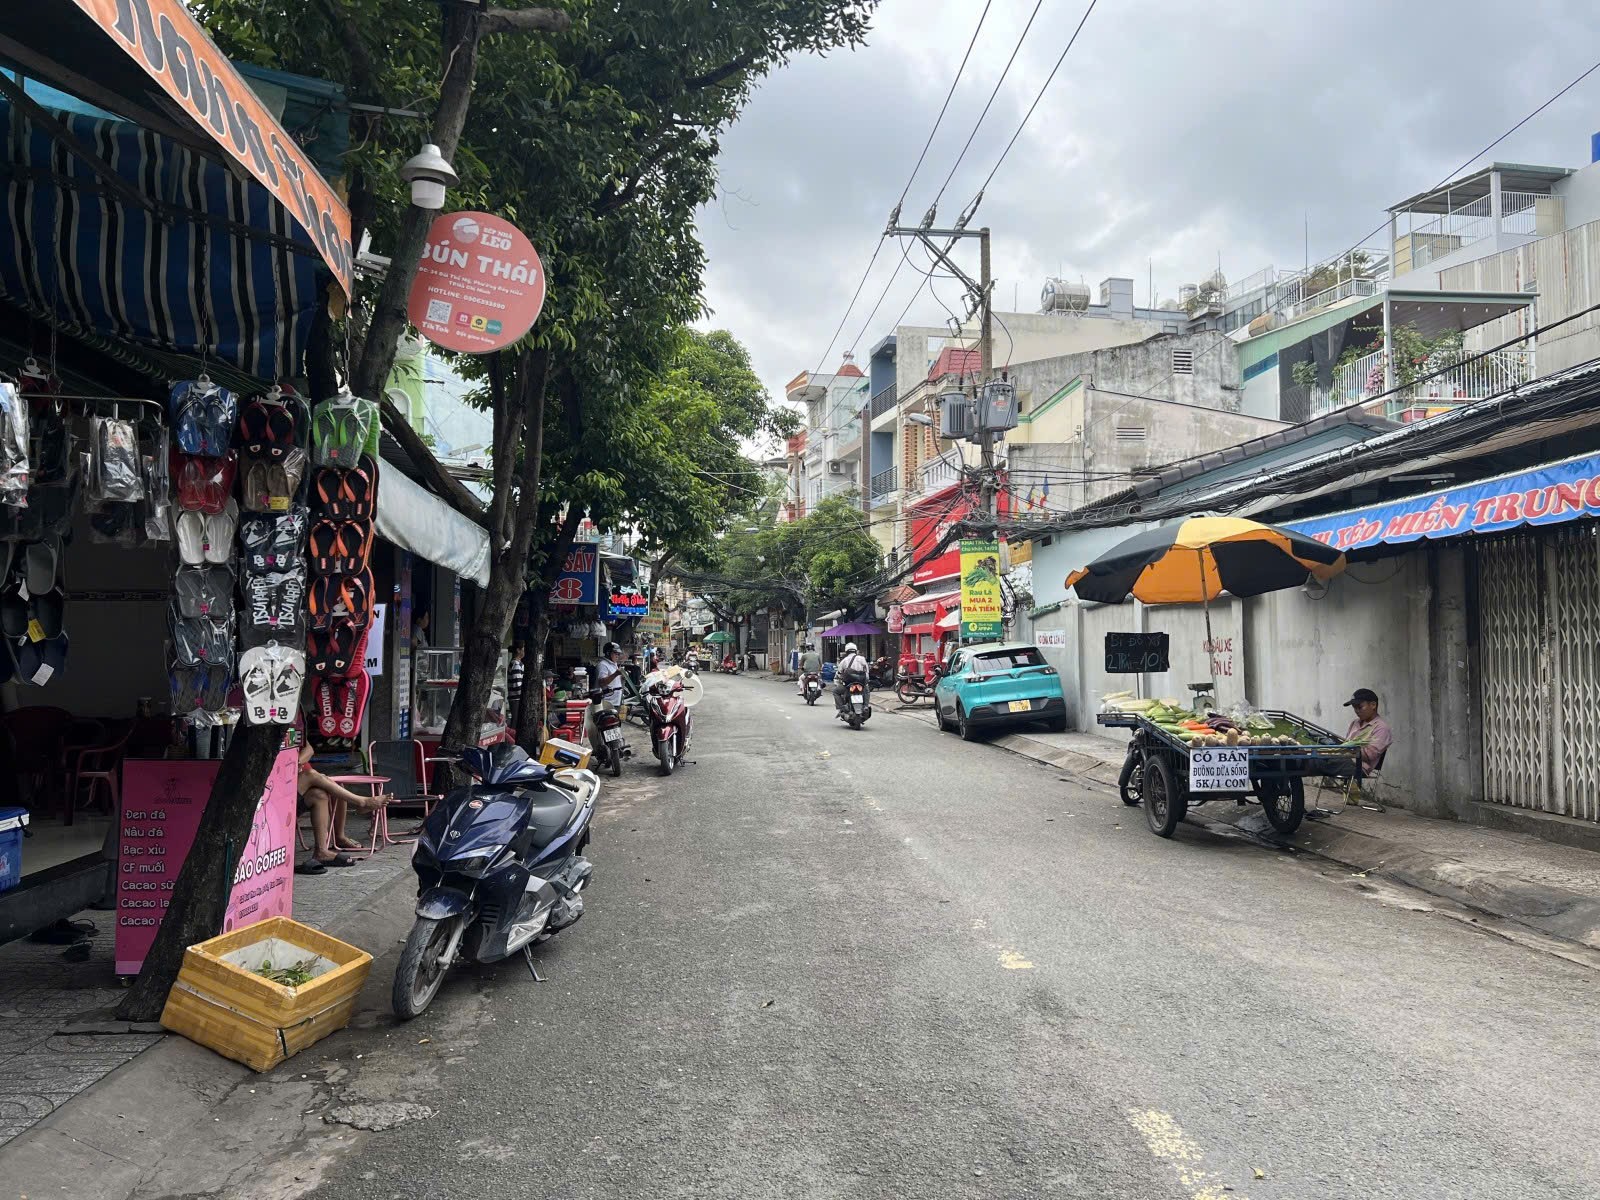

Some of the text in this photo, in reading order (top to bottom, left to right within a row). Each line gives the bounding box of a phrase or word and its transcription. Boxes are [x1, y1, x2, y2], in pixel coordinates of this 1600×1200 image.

[481, 234, 513, 250] LEO
[477, 255, 537, 285] THÁI
[422, 321, 449, 334] TikTok
[1380, 496, 1469, 538] MIỀN
[562, 546, 595, 573] SẤY
[1106, 654, 1118, 669] 2
[1193, 750, 1248, 763] CÓ BÁN
[1193, 764, 1215, 777] ĐUÔNG
[1230, 762, 1248, 776] SỐNG
[1195, 778, 1246, 789] 5K/1 CON
[125, 809, 166, 820] Đen đá
[124, 826, 164, 837] Nâu đá
[123, 845, 144, 857] Bạc
[122, 860, 165, 873] CF muối
[255, 847, 286, 875] COFFEE
[121, 880, 157, 890] Cacao
[120, 898, 156, 908] Cacao
[120, 916, 156, 926] Cacao
